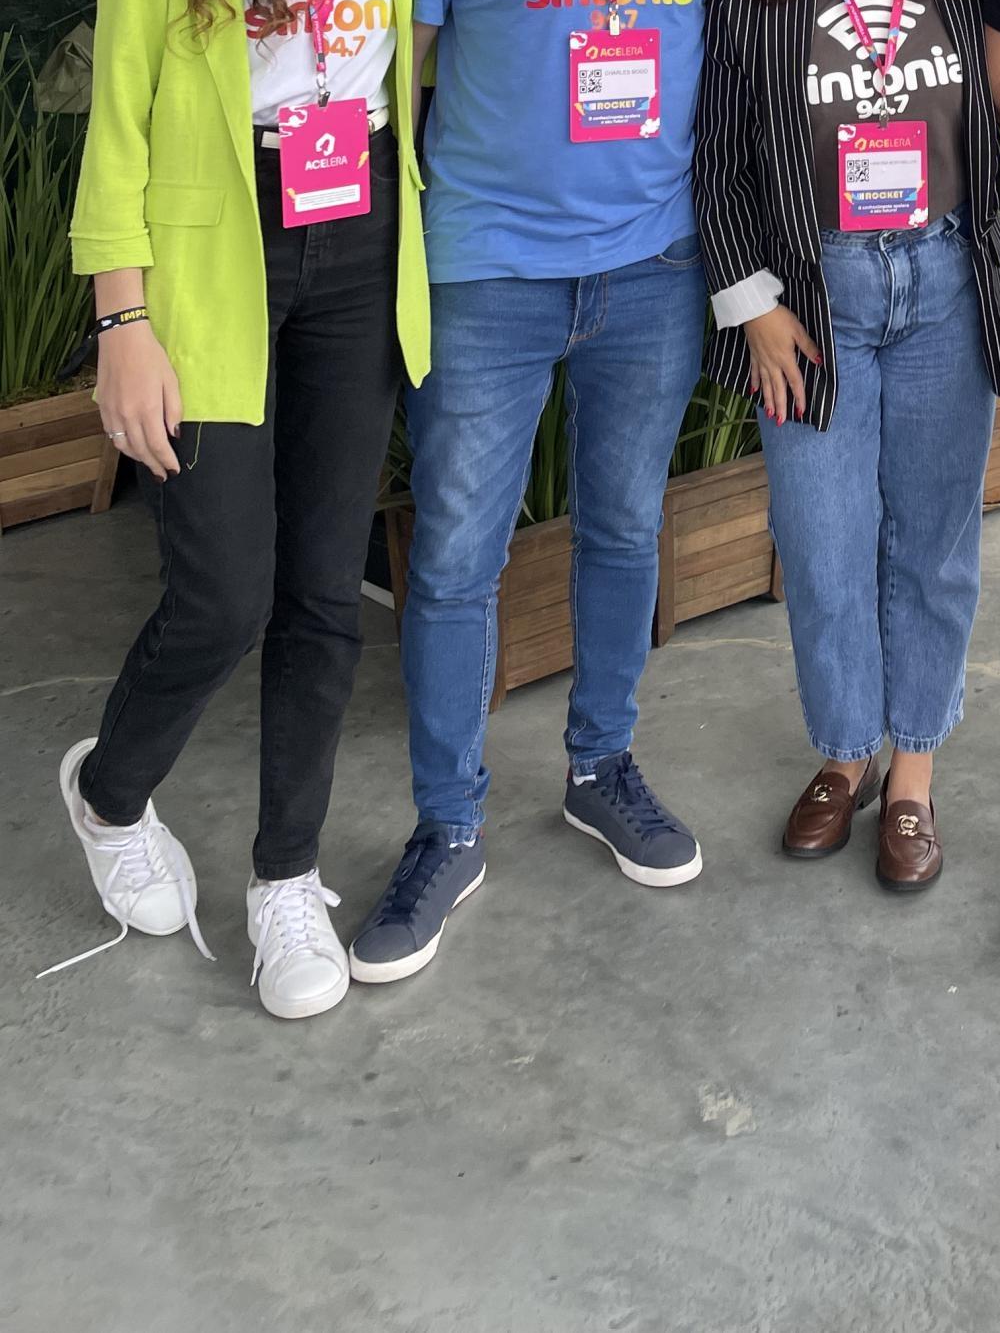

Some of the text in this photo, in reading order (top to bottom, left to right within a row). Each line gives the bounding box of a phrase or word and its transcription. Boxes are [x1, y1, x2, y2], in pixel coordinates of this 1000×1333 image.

[600, 46, 644, 58] ACELERA
[597, 99, 636, 110] ROCKET
[856, 94, 909, 119] 94.7
[869, 138, 911, 148] ACELERA
[305, 155, 349, 171] ACELERA
[865, 190, 904, 199] ROCKET
